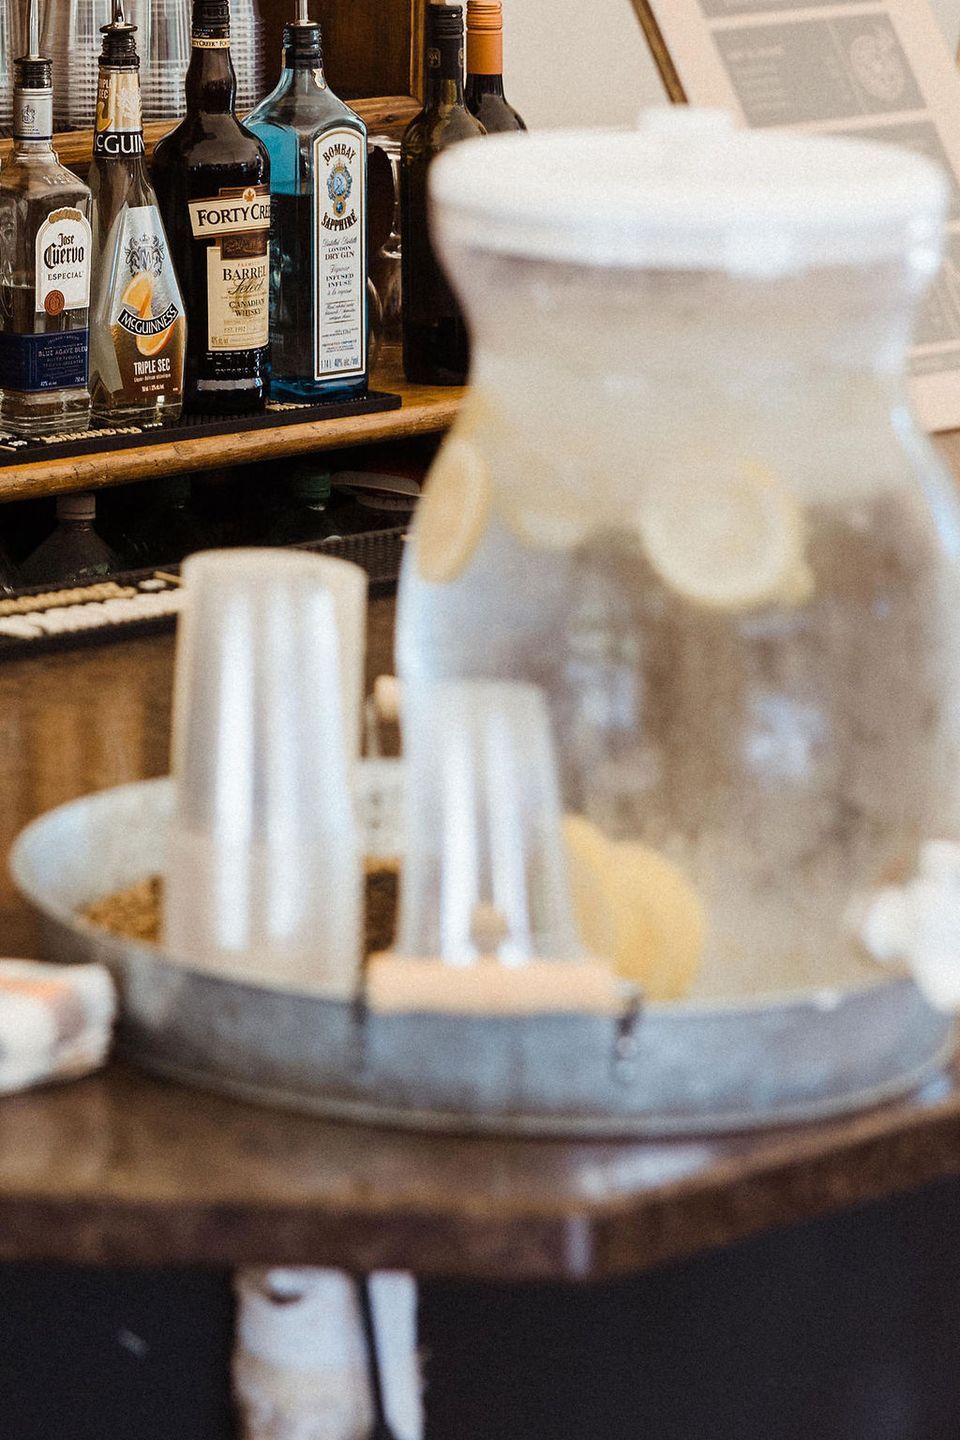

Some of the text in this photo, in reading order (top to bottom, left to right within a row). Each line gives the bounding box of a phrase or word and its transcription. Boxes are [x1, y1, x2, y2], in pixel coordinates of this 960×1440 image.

[95, 134, 145, 153] cGUIN
[322, 143, 356, 166] BOMBAY
[197, 207, 250, 226] FORTY
[320, 209, 358, 231] SAPPHIRE
[58, 233, 75, 248] Jose
[327, 245, 352, 253] LONDON
[43, 243, 84, 269] Cuervo
[47, 271, 83, 281] ESPECIAL
[223, 265, 266, 281] BARREL
[122, 309, 177, 335] McGUINNESS
[133, 358, 171, 375] TRIPLE SEC
